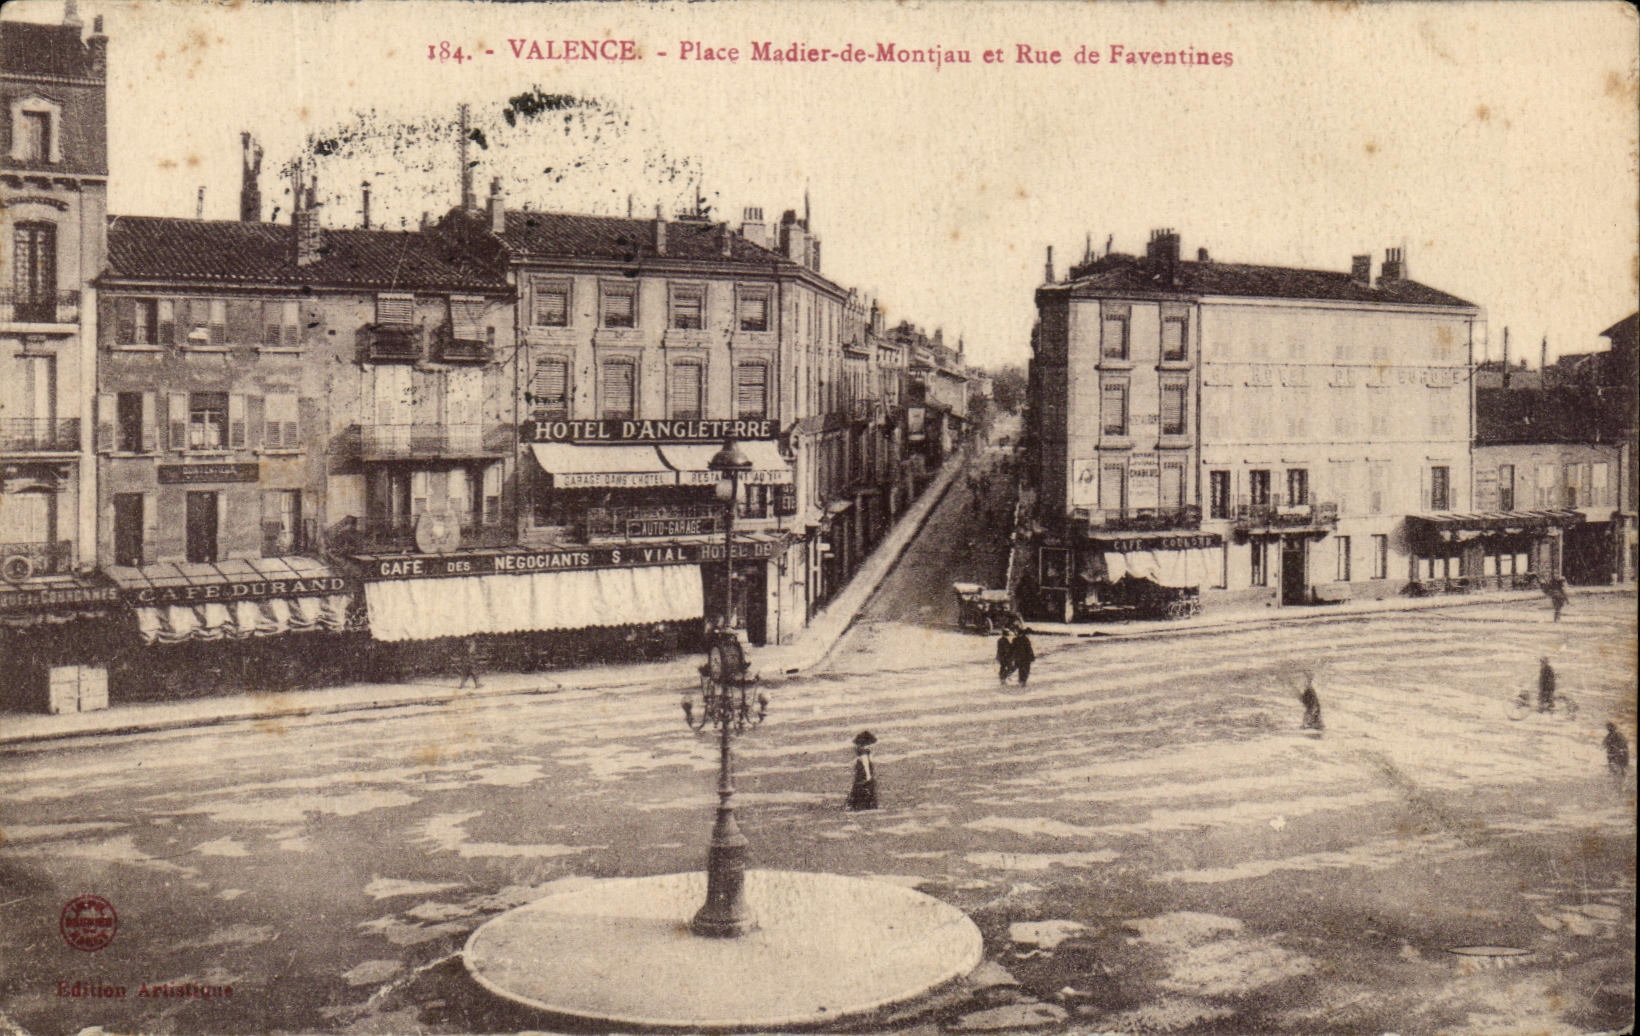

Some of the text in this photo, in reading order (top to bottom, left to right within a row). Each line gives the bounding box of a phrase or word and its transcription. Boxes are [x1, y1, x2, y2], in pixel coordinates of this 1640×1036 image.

[534, 420, 771, 440] HOTEL D'ANGLETERRE
[564, 474, 600, 486] GARAGE
[604, 474, 627, 485] DANS
[641, 520, 702, 536] AUTO-GARAGE
[447, 561, 471, 572] DES
[644, 548, 687, 562] VIAL
[231, 578, 345, 597] DURAND
